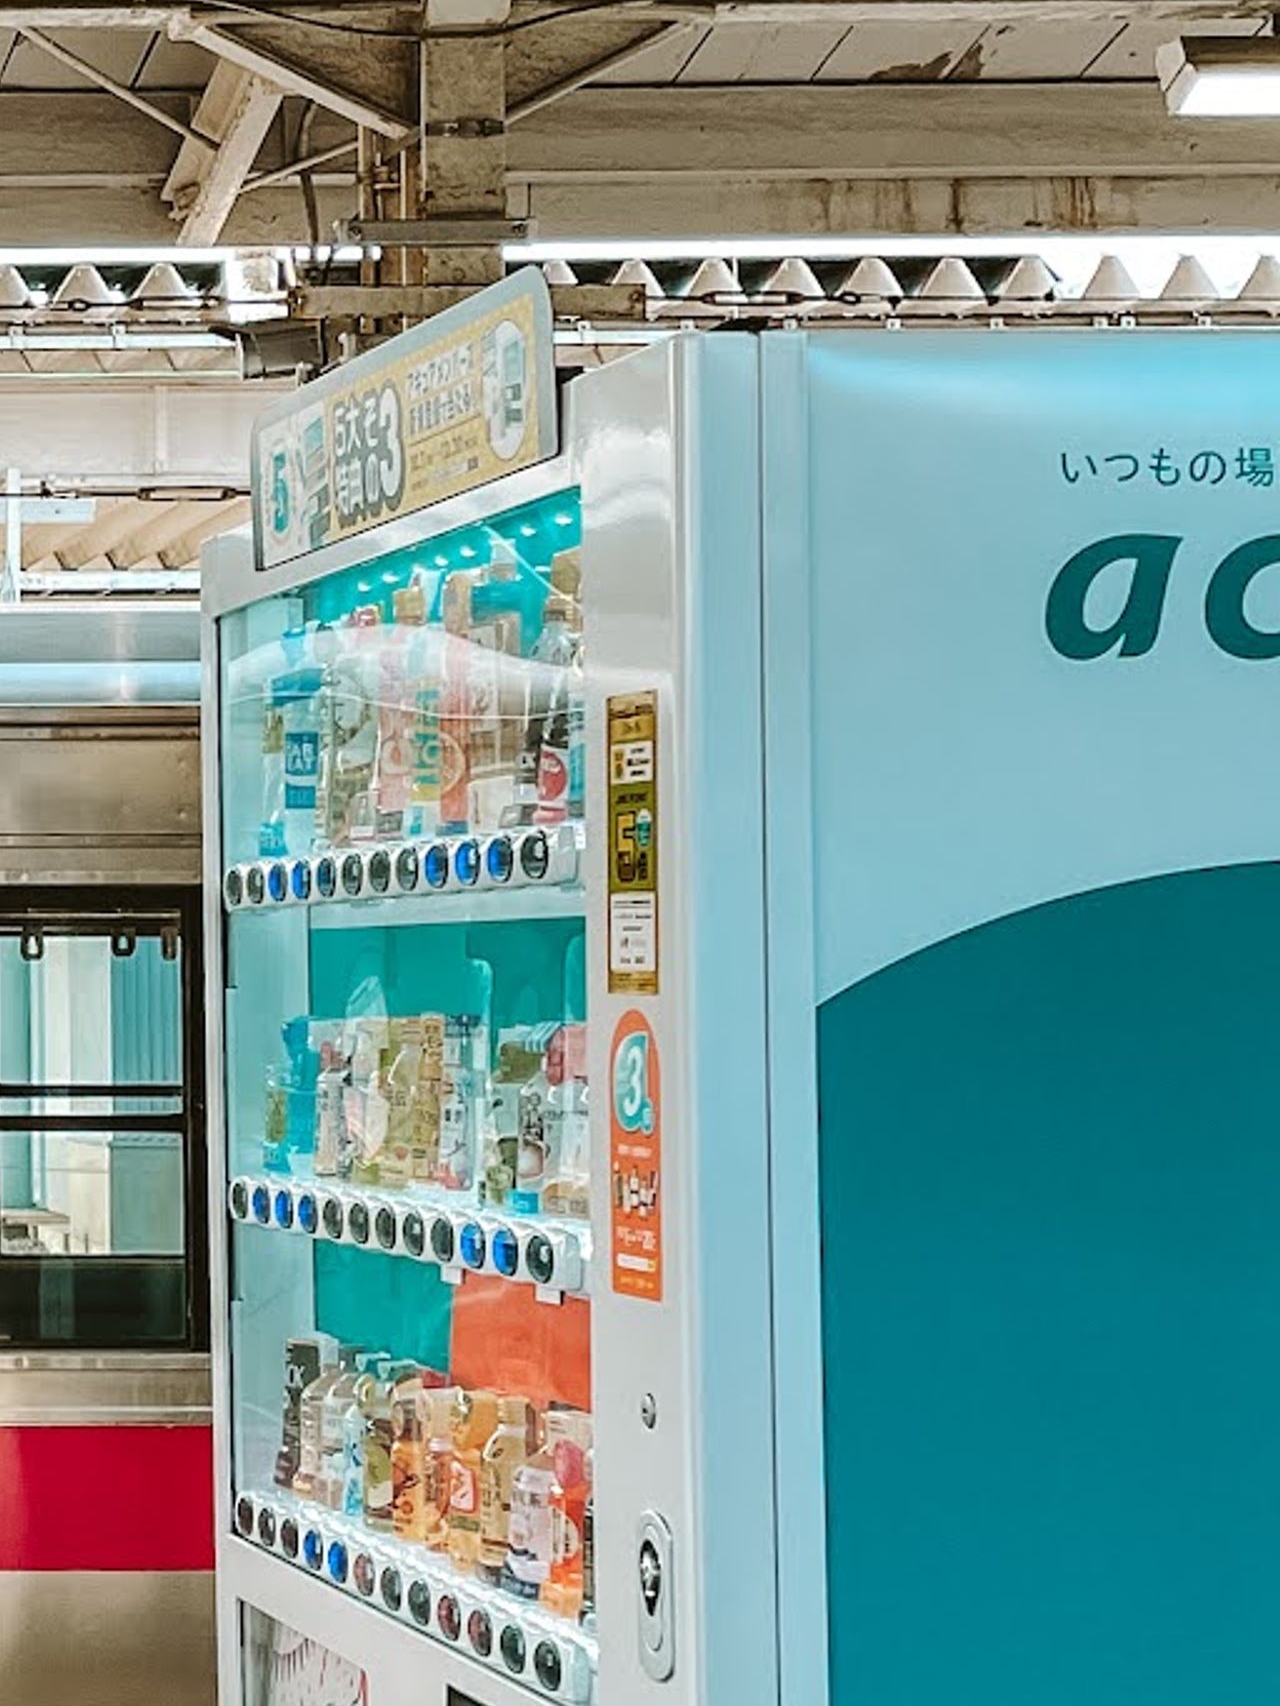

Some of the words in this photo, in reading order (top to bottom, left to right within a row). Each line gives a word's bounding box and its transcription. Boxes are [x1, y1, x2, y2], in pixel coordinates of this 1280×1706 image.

[1059, 447, 1275, 488] いつもの場
